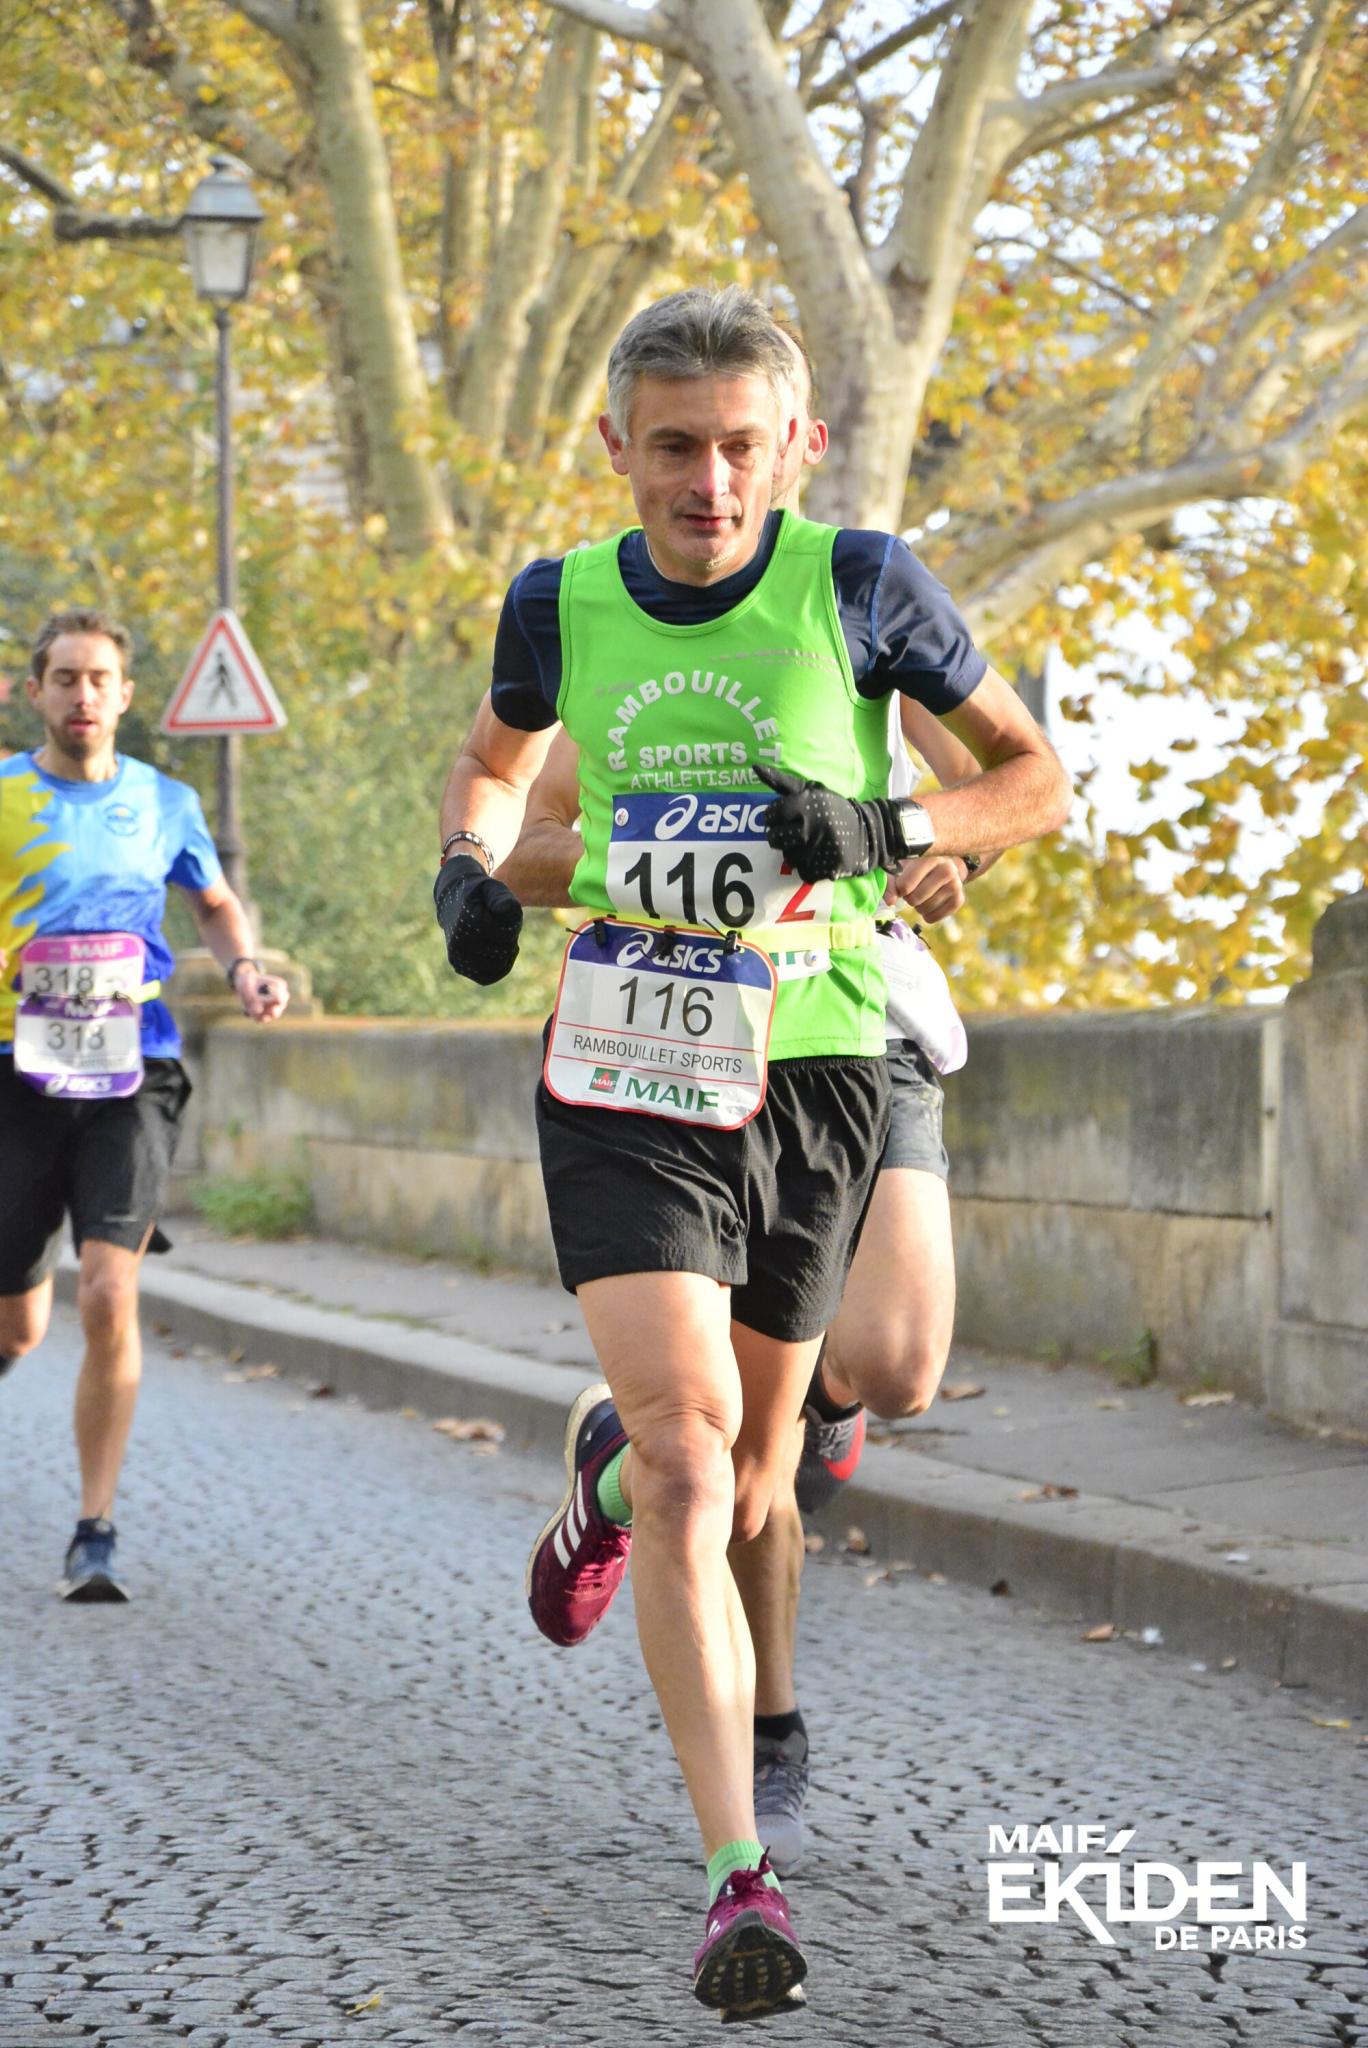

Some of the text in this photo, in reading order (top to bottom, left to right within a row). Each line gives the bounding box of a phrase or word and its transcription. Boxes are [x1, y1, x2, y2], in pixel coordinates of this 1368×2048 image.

[608, 670, 782, 772] RAMBOUILLET
[639, 742, 748, 769] SPORTS
[630, 767, 763, 790] ATHLETISME
[698, 804, 770, 834] asic
[624, 852, 755, 928] 116
[35, 966, 94, 993] 318
[618, 976, 714, 1037] 116
[573, 1034, 742, 1073] RAMBOUILLET SPORTS
[592, 1077, 617, 1087] MAIF
[625, 1076, 719, 1113] MAIF
